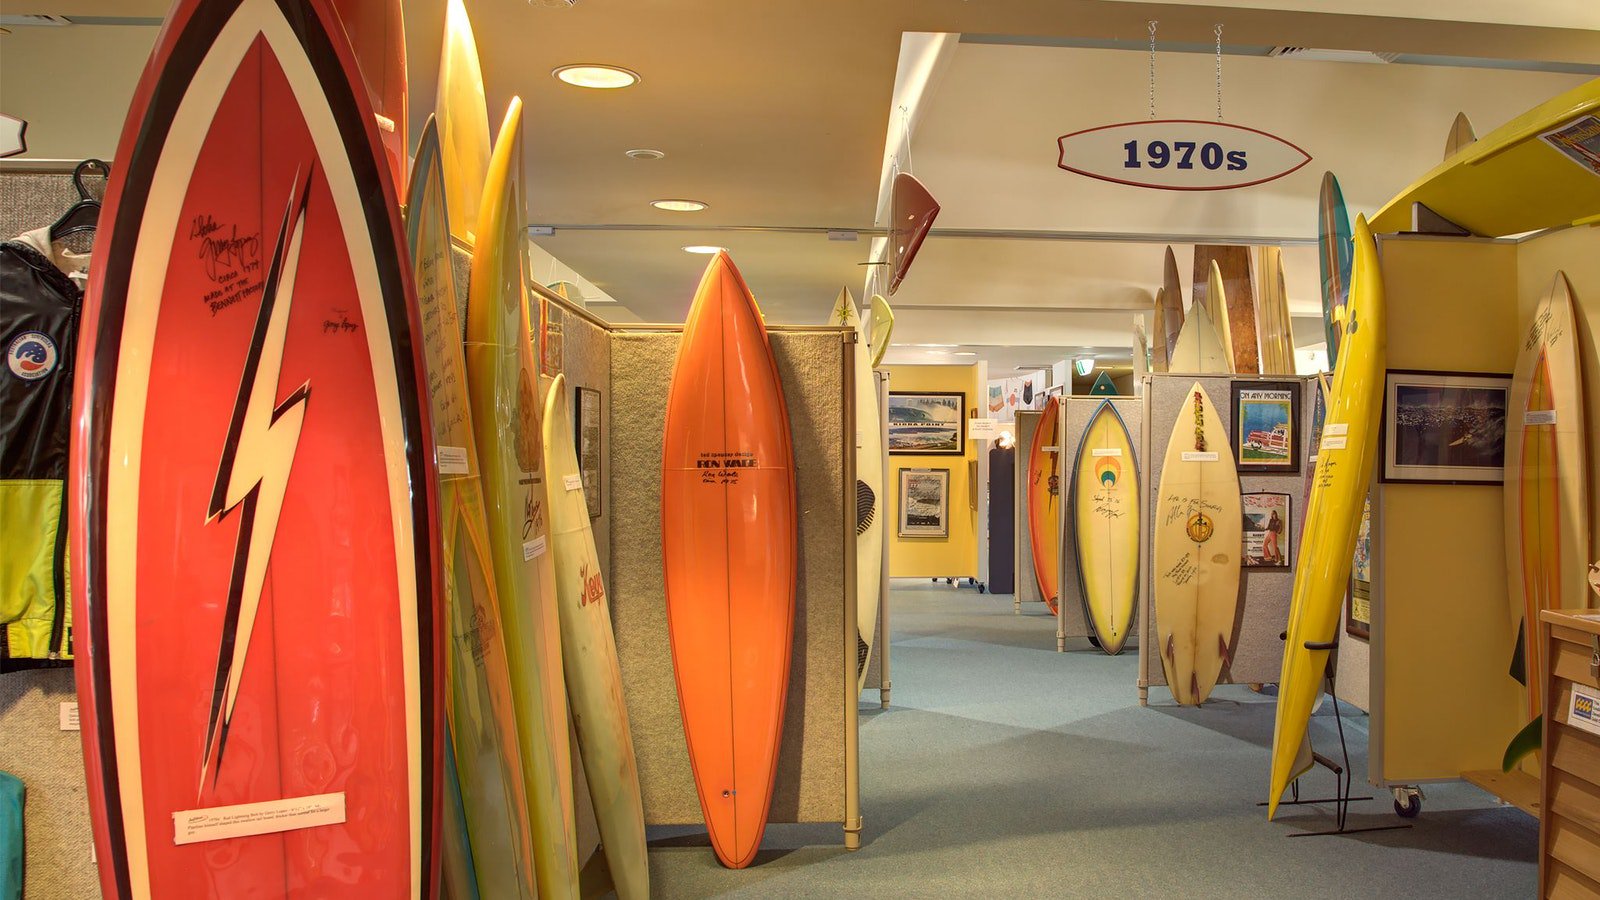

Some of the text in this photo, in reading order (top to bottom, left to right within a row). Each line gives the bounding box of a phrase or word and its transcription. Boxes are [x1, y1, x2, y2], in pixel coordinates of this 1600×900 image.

[1124, 140, 1248, 171] 1970s
[1251, 392, 1263, 400] ANY
[1264, 392, 1291, 400] MORNING
